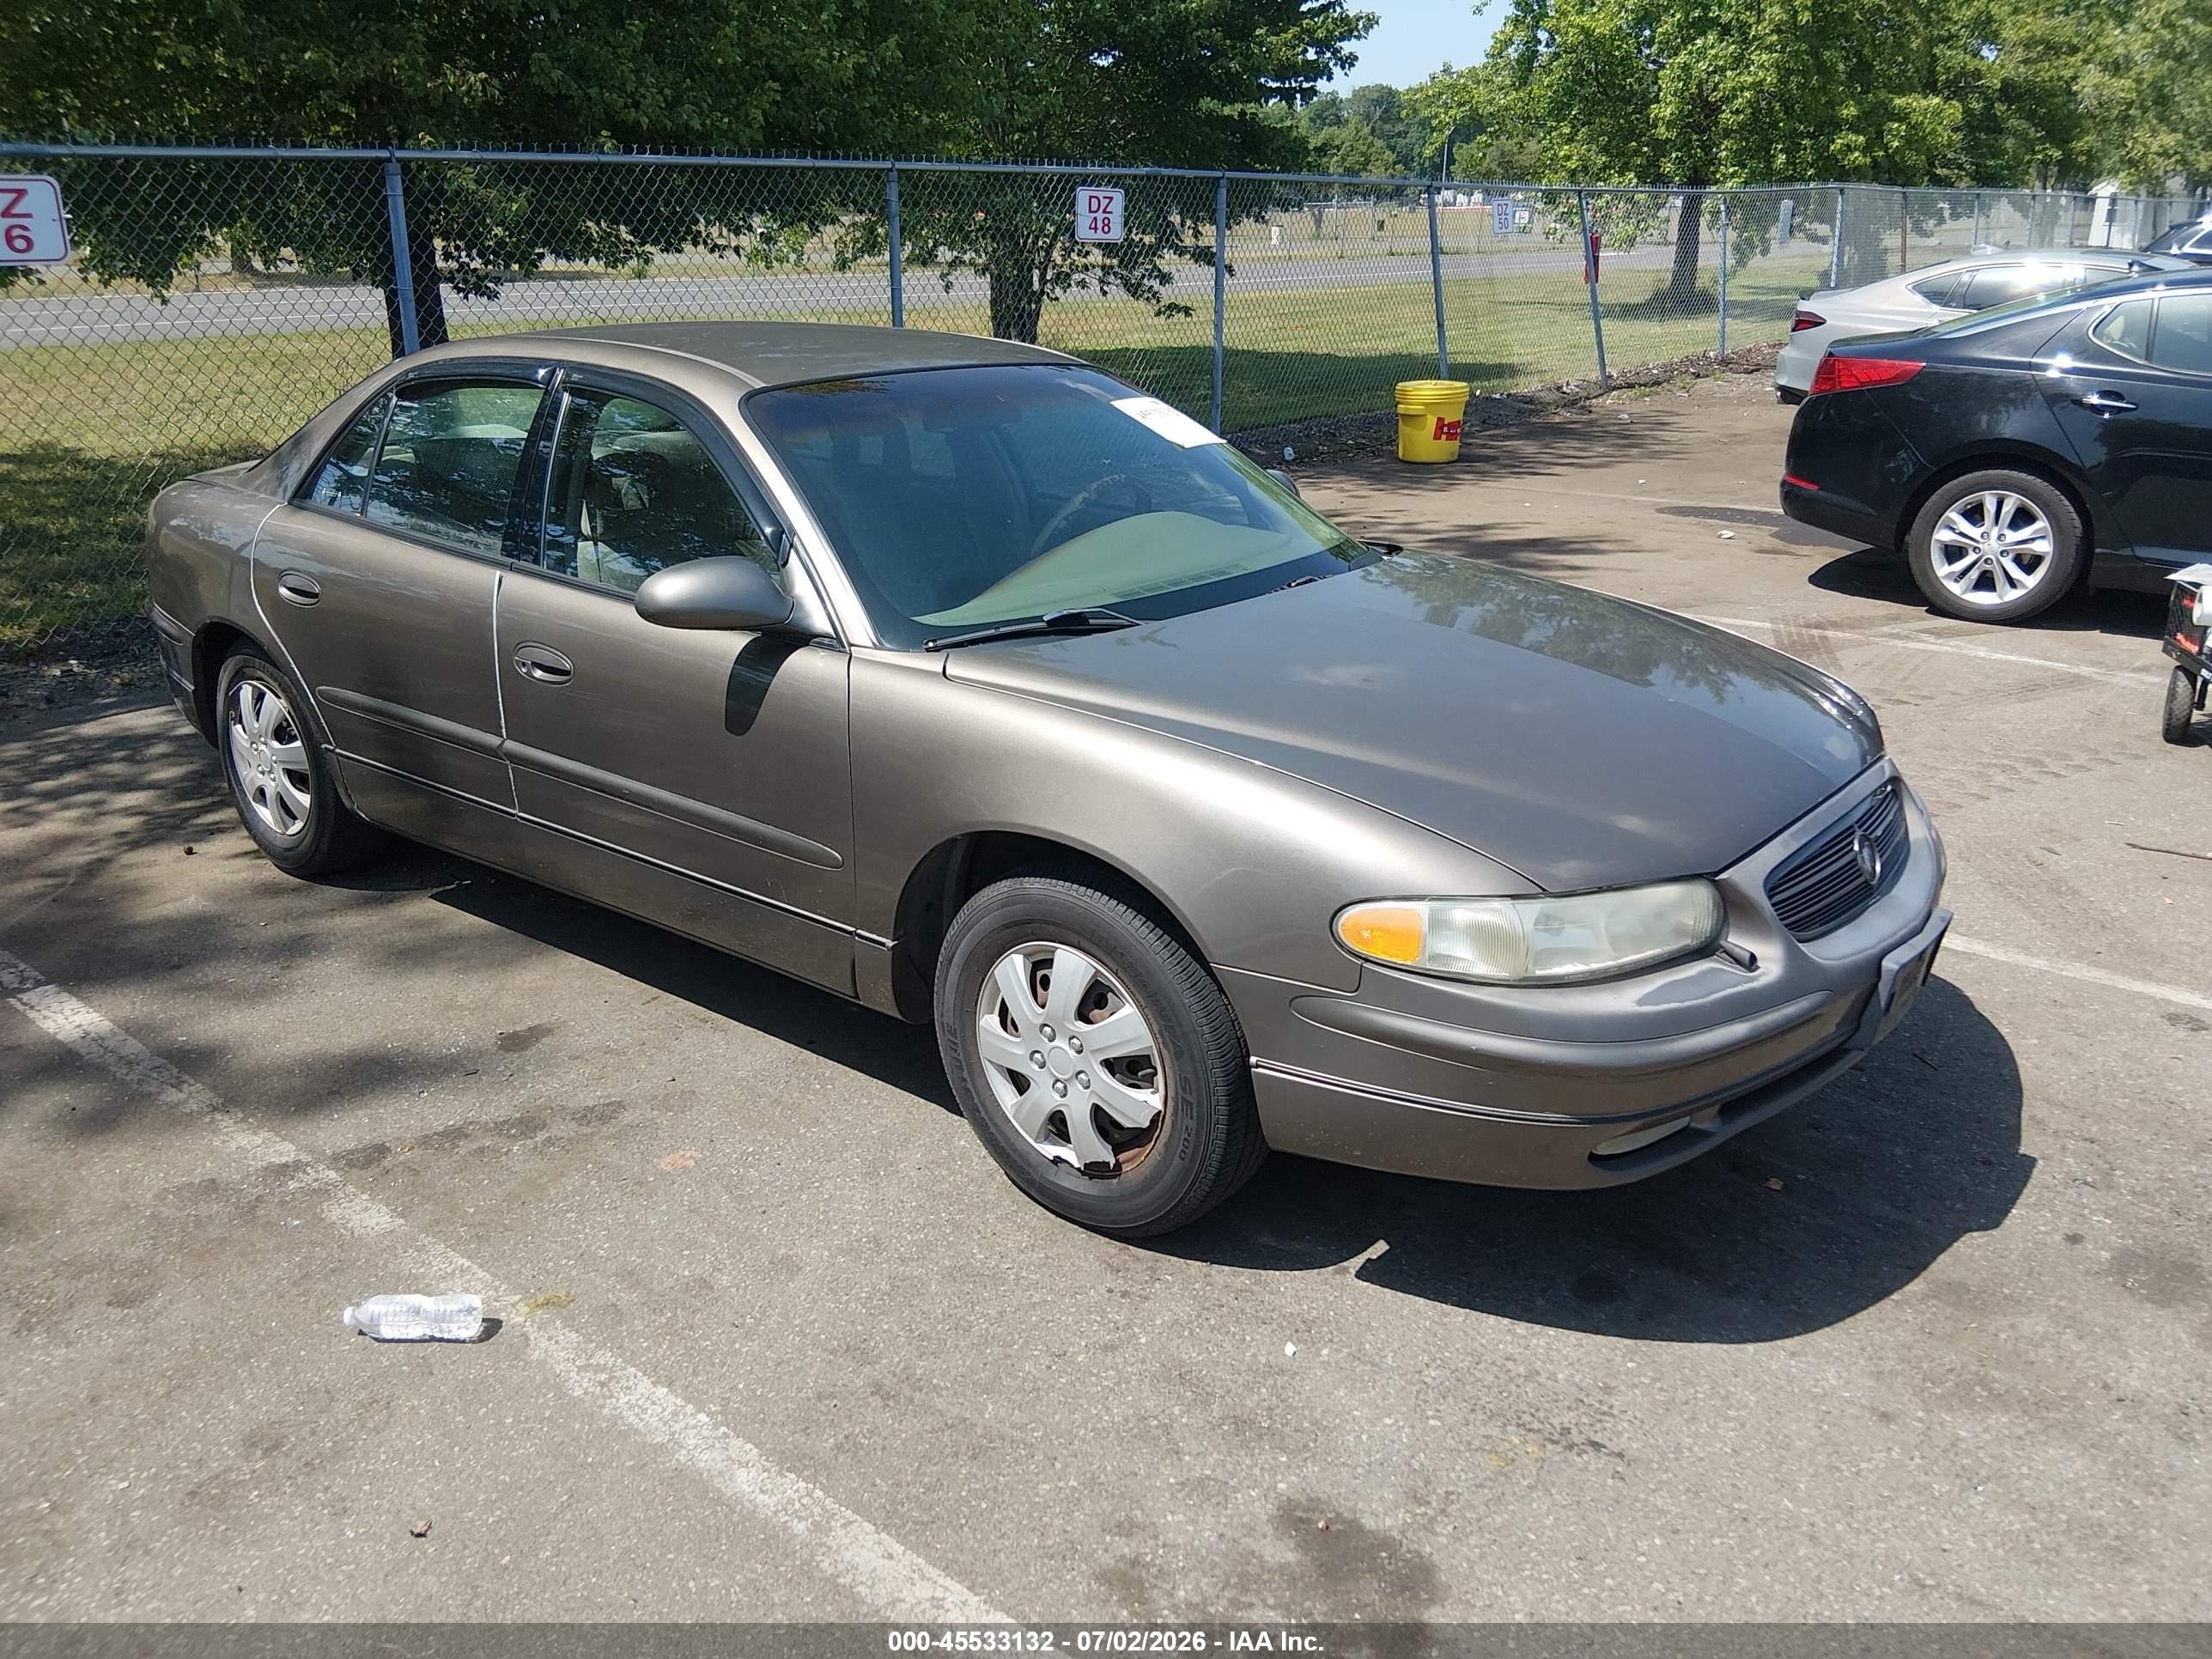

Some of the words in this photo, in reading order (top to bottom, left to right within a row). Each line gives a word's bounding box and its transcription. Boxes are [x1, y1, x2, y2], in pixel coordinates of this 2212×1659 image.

[1088, 195, 1114, 214] DZ
[1498, 203, 1509, 216] DZ
[1088, 216, 1111, 234] 48
[1498, 217, 1509, 230] 50
